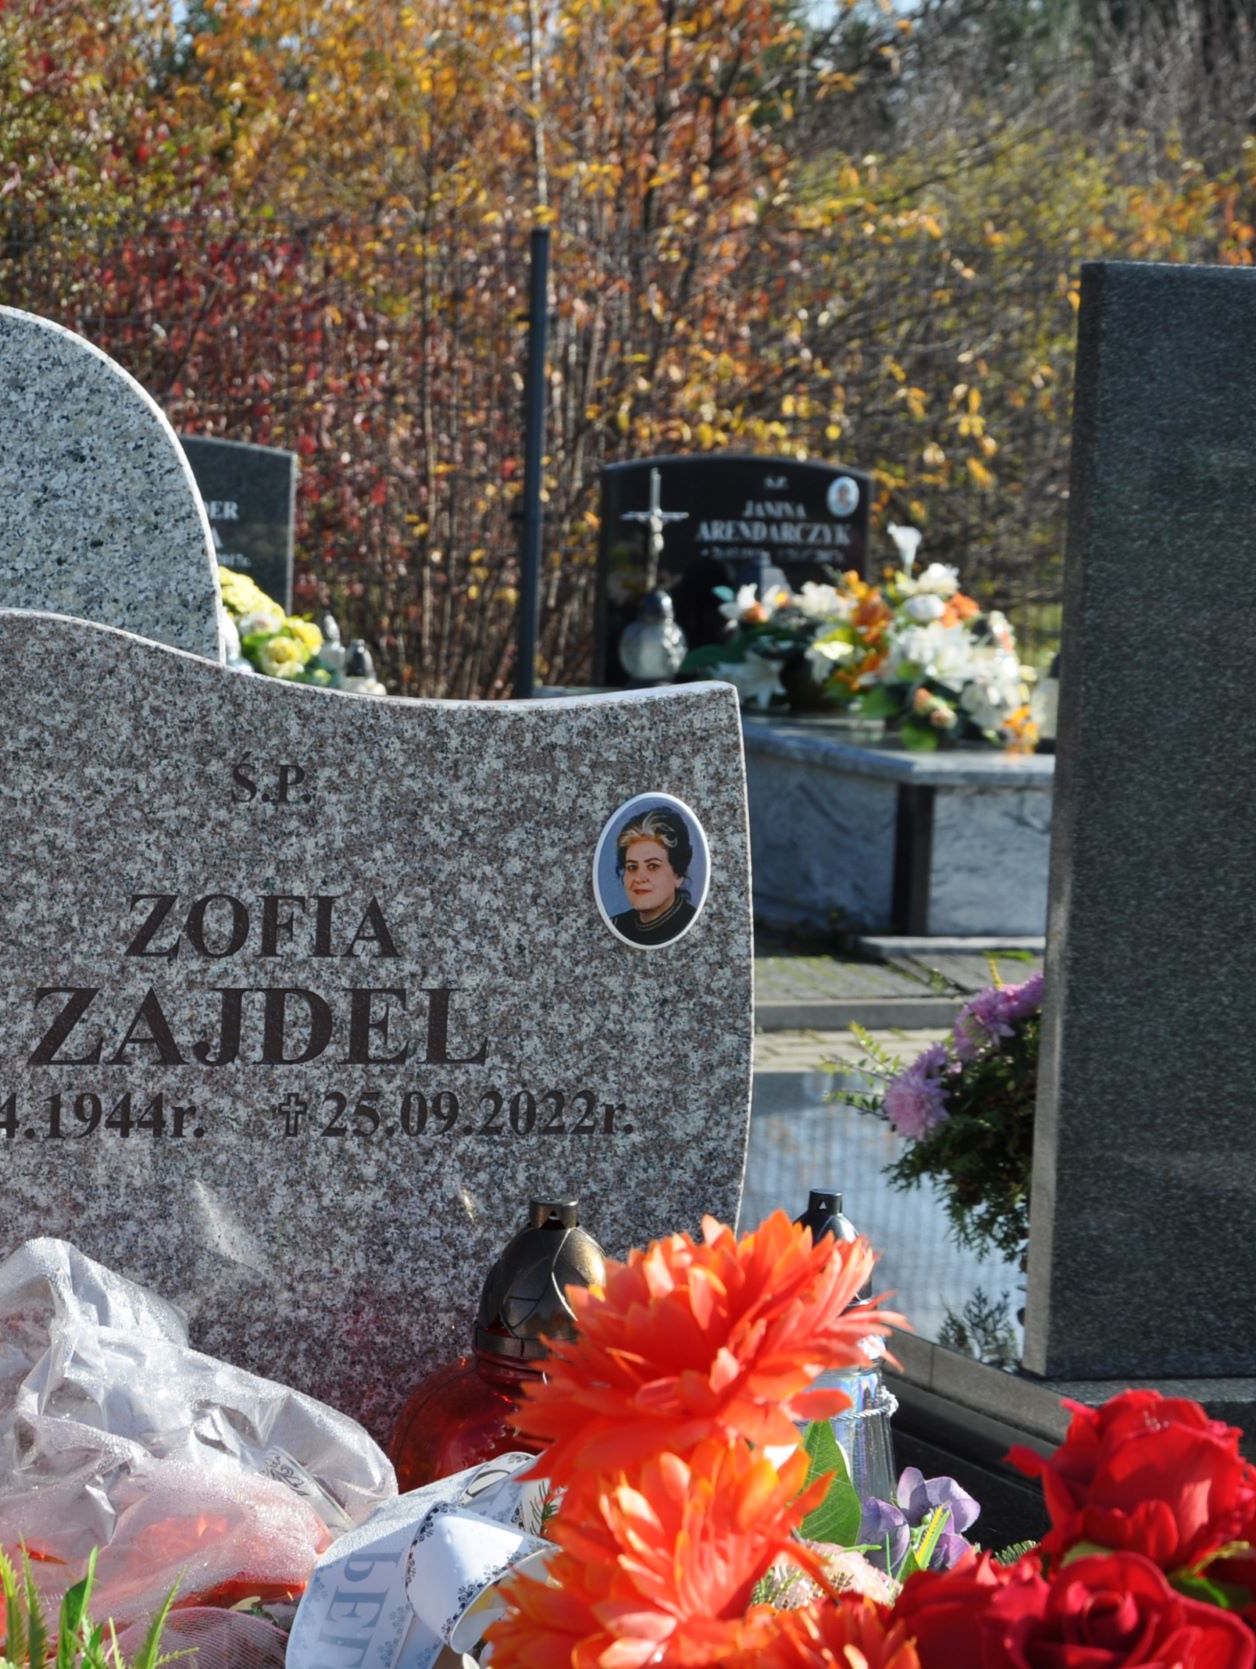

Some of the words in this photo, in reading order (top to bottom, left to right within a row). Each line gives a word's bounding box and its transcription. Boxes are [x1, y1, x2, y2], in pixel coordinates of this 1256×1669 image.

[743, 500, 807, 519] JANINA
[232, 752, 312, 801] Ś.P.
[123, 895, 400, 958] ZOFIA
[29, 987, 488, 1065] ZAJDEL
[320, 1090, 633, 1137] 25.09.2022r.
